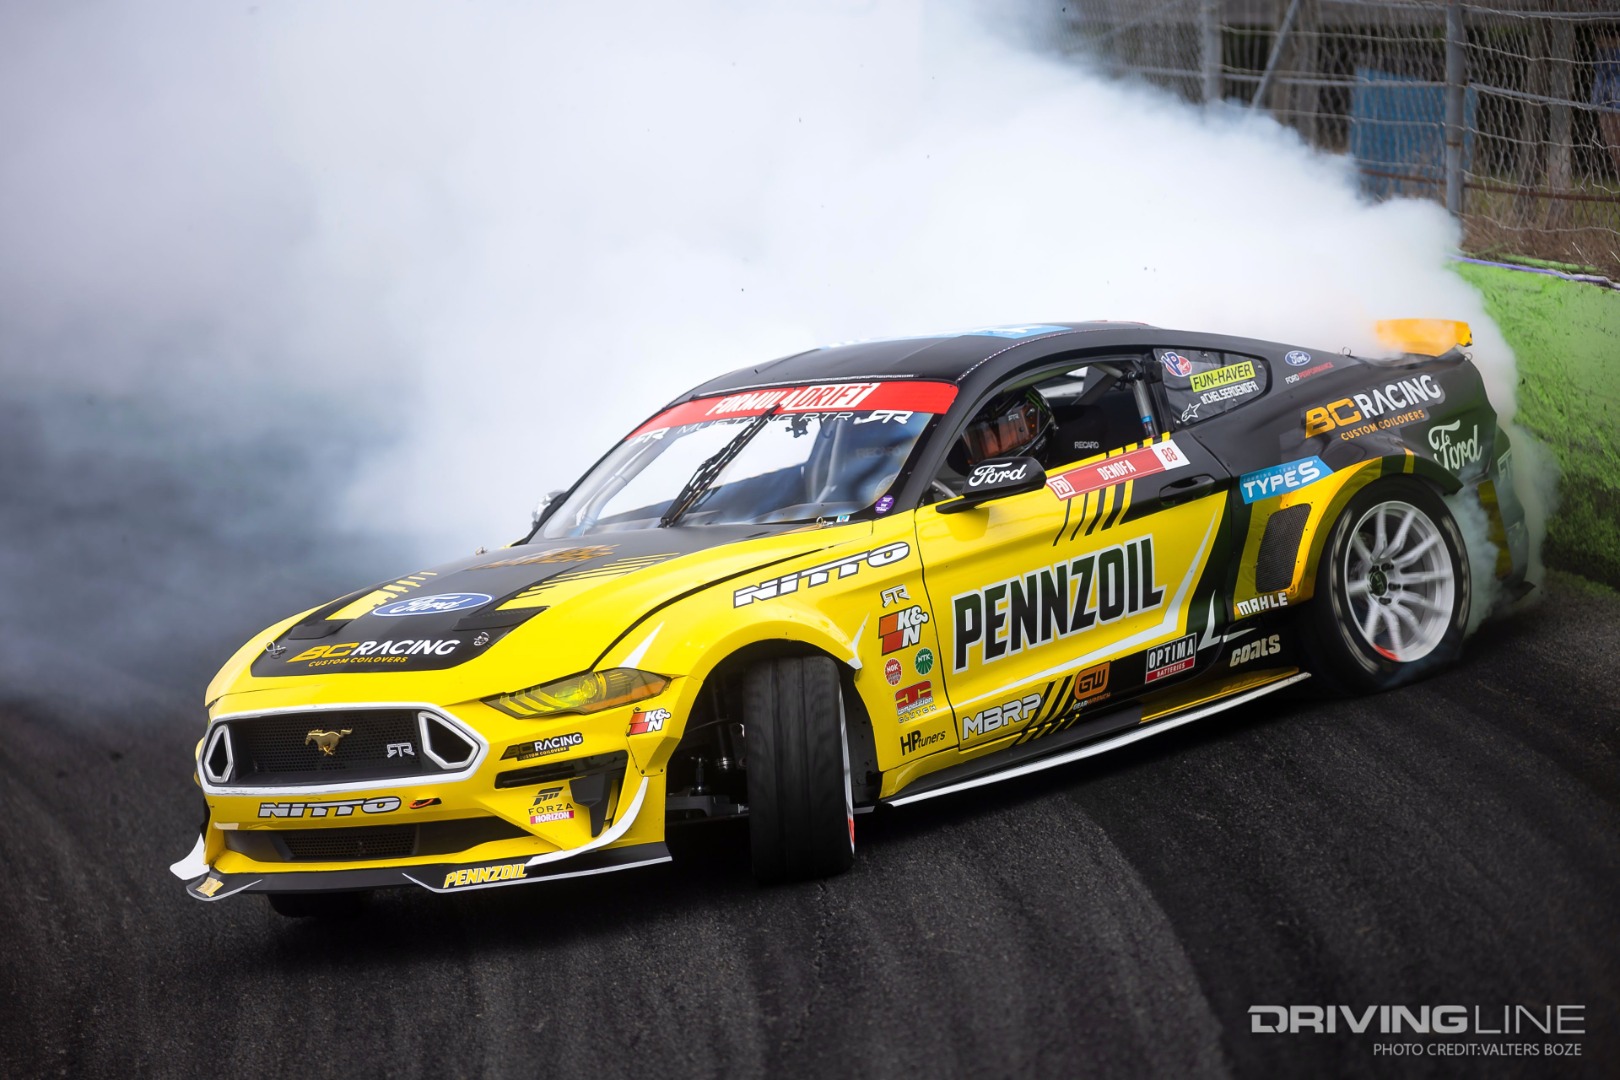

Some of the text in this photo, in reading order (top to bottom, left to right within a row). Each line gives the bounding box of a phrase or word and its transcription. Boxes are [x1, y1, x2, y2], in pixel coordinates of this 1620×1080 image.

[1192, 364, 1252, 390] FUN-HAVER
[799, 411, 854, 423] RTR
[1340, 409, 1426, 441] CUSTOM COILOVERS
[1074, 441, 1100, 449] RECARO
[1160, 447, 1178, 463] 88
[1428, 419, 1483, 471] Ford
[968, 462, 1027, 487] Ford
[1096, 460, 1137, 481] DENOFA
[733, 541, 911, 608] NITTO
[951, 533, 1168, 675] PENNZOIL
[1236, 592, 1288, 616] MAHLE
[308, 656, 408, 667] CUSTOM COILOVERS
[917, 653, 931, 663] NTK
[1149, 637, 1195, 669] OPTIMA
[886, 663, 899, 673] NGK
[1156, 662, 1186, 678] BATTERIES
[898, 704, 936, 723] CLUTCH
[962, 693, 1042, 740] MBRP
[258, 796, 402, 818] NITTO
[528, 803, 574, 815] FORZA
[535, 811, 570, 823] HORIZON
[443, 863, 528, 888] PENNZOIL
